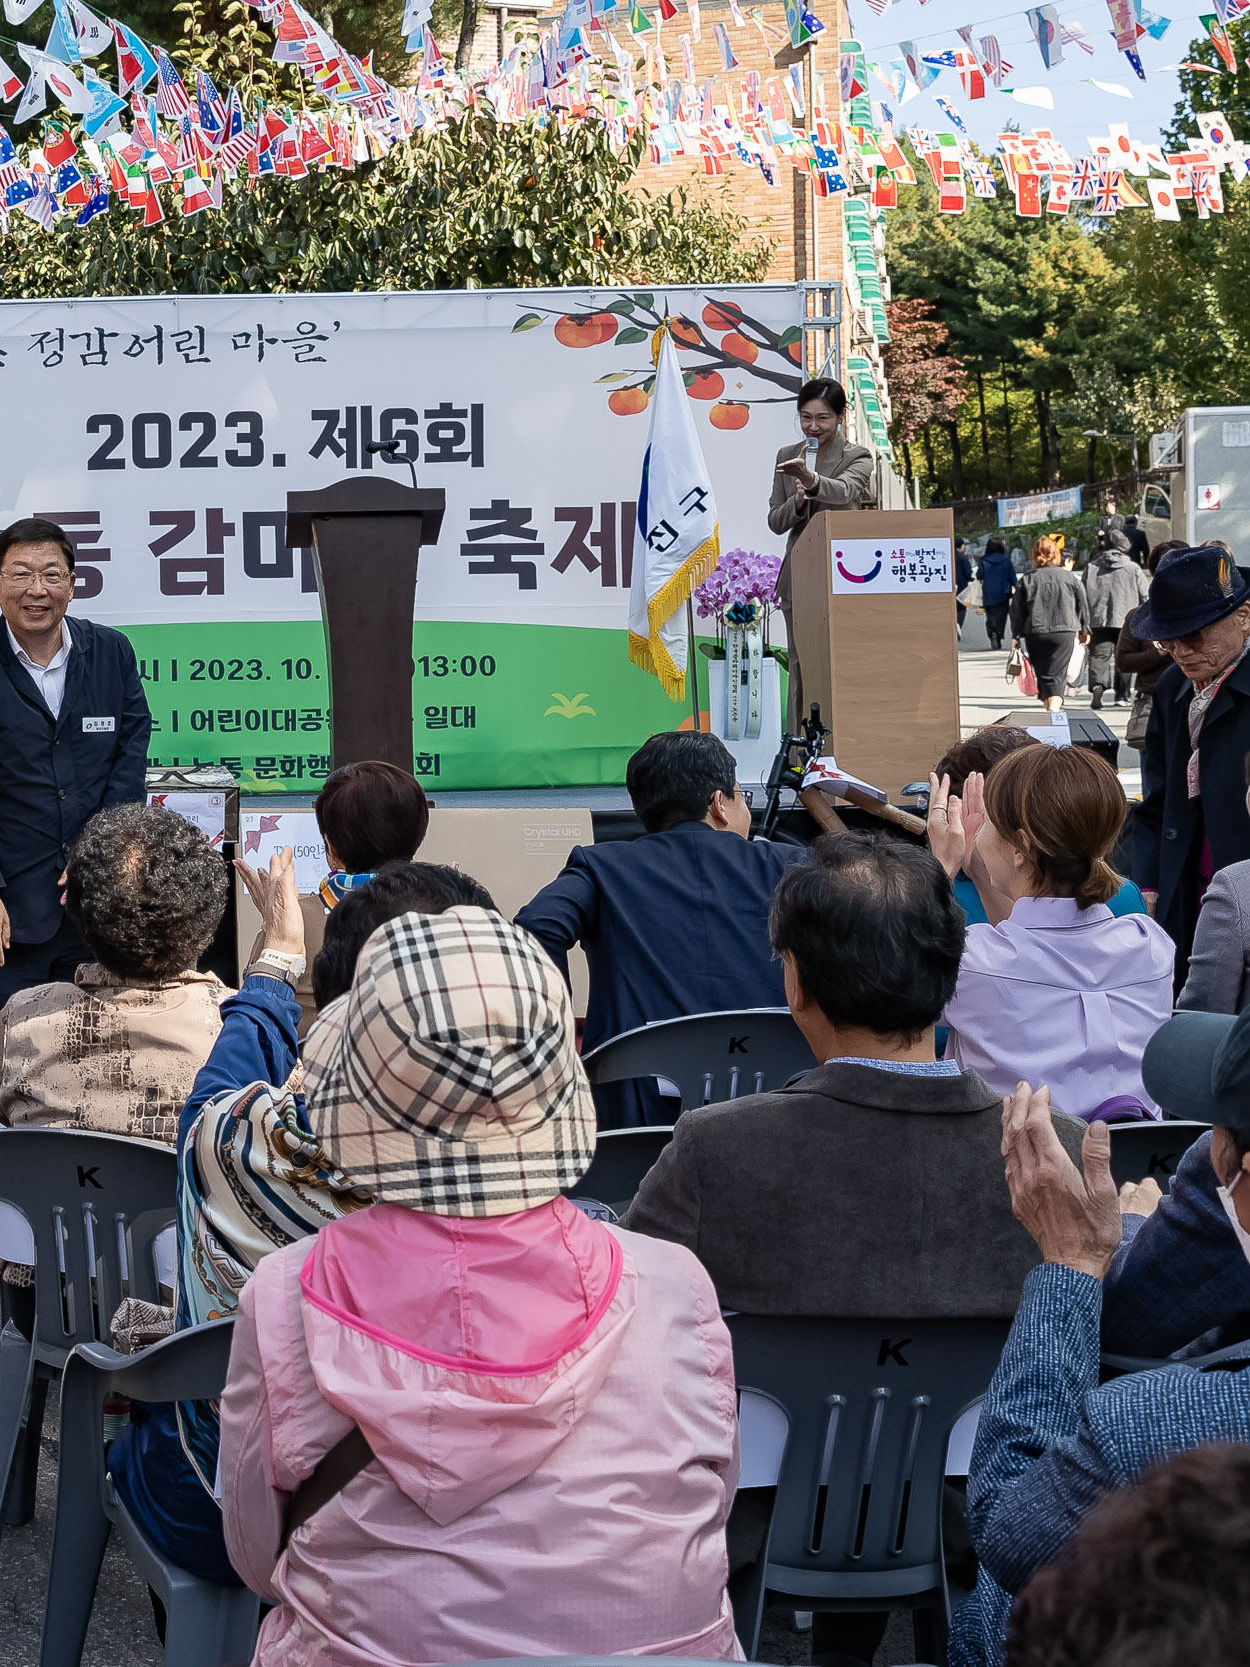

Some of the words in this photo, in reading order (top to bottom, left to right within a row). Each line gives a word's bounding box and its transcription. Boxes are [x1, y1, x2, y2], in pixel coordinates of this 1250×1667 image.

[28, 325, 211, 367] 정감어린
[86, 410, 288, 471] 2023.
[310, 401, 485, 470] 제6회
[647, 486, 708, 553] 진구
[459, 499, 637, 592] 축제
[891, 563, 947, 583] 행복광진
[189, 659, 271, 681] 2023.
[280, 658, 321, 680] 10.
[424, 706, 476, 729] 일대
[524, 828, 559, 838] Crystal
[562, 828, 581, 836] UHD
[728, 1036, 750, 1054] K
[76, 1165, 104, 1190] K
[877, 1338, 914, 1366] K
